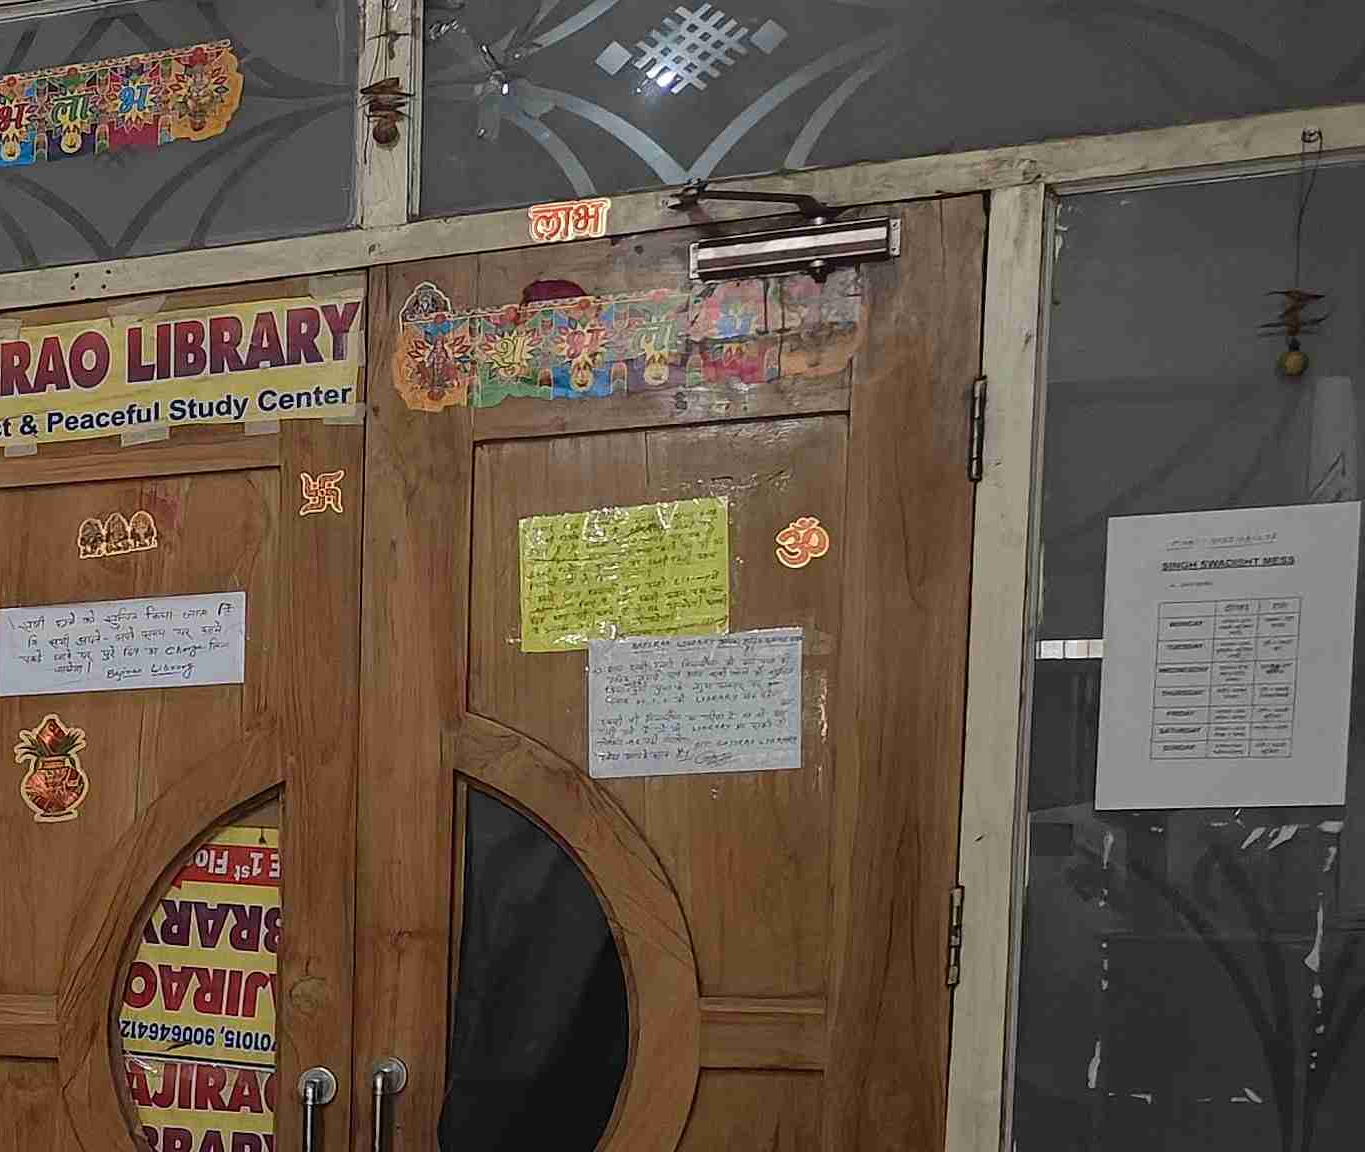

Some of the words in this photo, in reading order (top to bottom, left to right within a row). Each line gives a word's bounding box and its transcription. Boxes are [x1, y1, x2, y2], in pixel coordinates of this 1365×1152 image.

[530, 199, 609, 240] लाभ
[127, 302, 361, 384] LIBRARY
[20, 415, 38, 436] &
[47, 403, 160, 433] Peaceful
[169, 394, 249, 421] Study
[257, 385, 352, 412] Center
